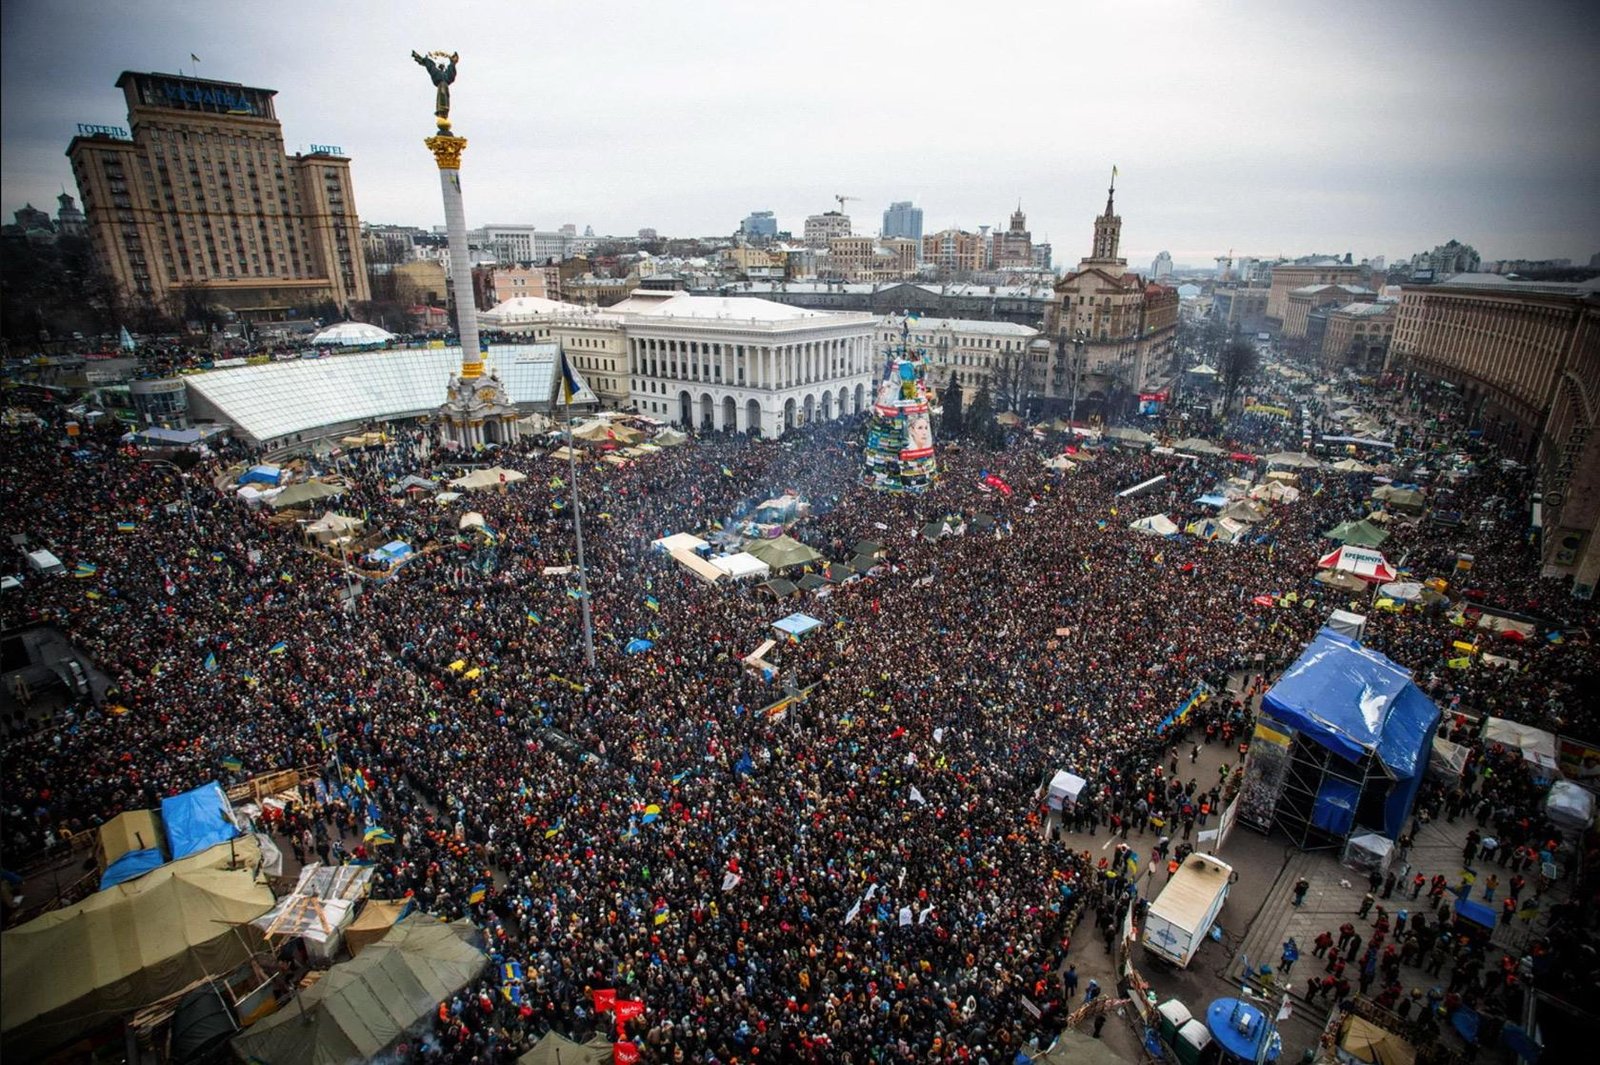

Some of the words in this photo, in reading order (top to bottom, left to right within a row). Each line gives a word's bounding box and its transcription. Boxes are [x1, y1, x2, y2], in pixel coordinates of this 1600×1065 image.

[77, 123, 128, 137] ГОТЕЛЬ
[310, 144, 345, 155] HOTEL
[1344, 552, 1383, 564] КРЕМЕНЧУК
